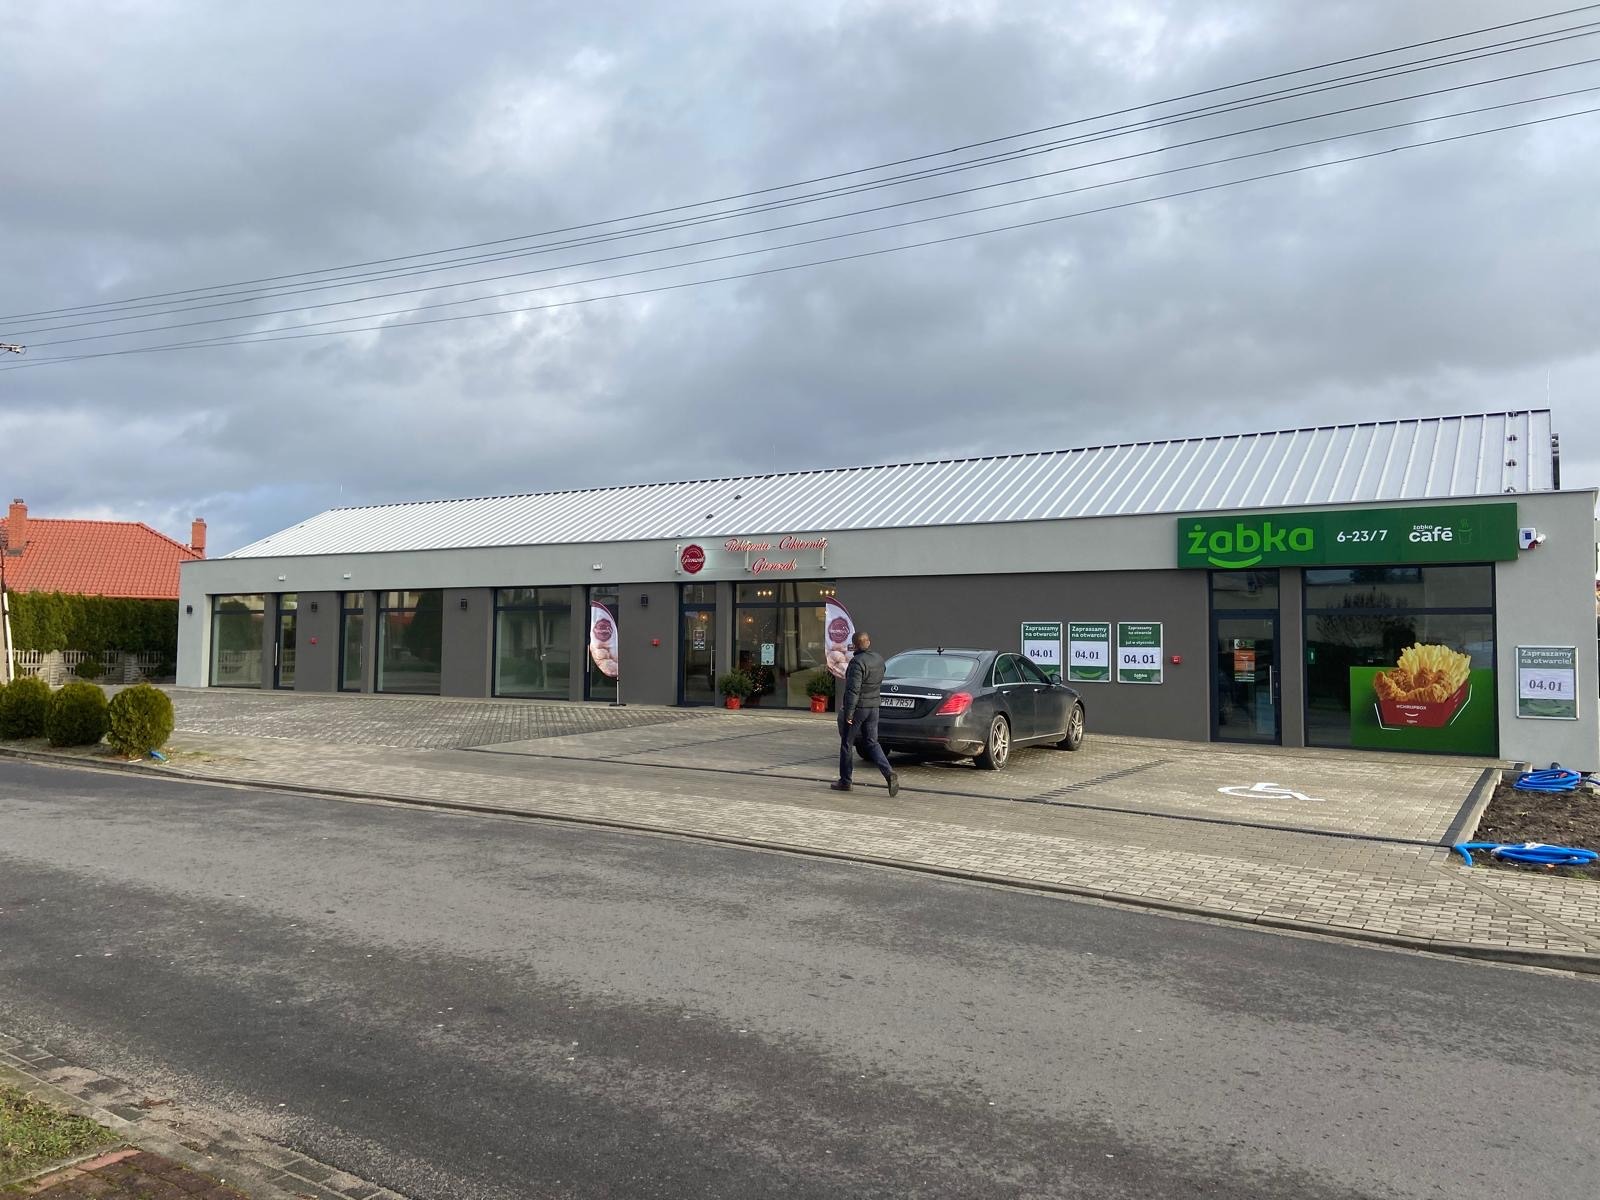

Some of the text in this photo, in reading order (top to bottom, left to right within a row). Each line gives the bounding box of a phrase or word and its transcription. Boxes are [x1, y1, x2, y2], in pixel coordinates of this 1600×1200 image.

[1188, 522, 1314, 554] żabka
[1336, 529, 1388, 543] 6-23/7
[1030, 649, 1053, 658] 04.01
[1075, 651, 1100, 660] 04.01
[1521, 649, 1572, 658] Zapraszamy
[1123, 654, 1156, 664] 04.01
[1529, 679, 1563, 692] 04.01
